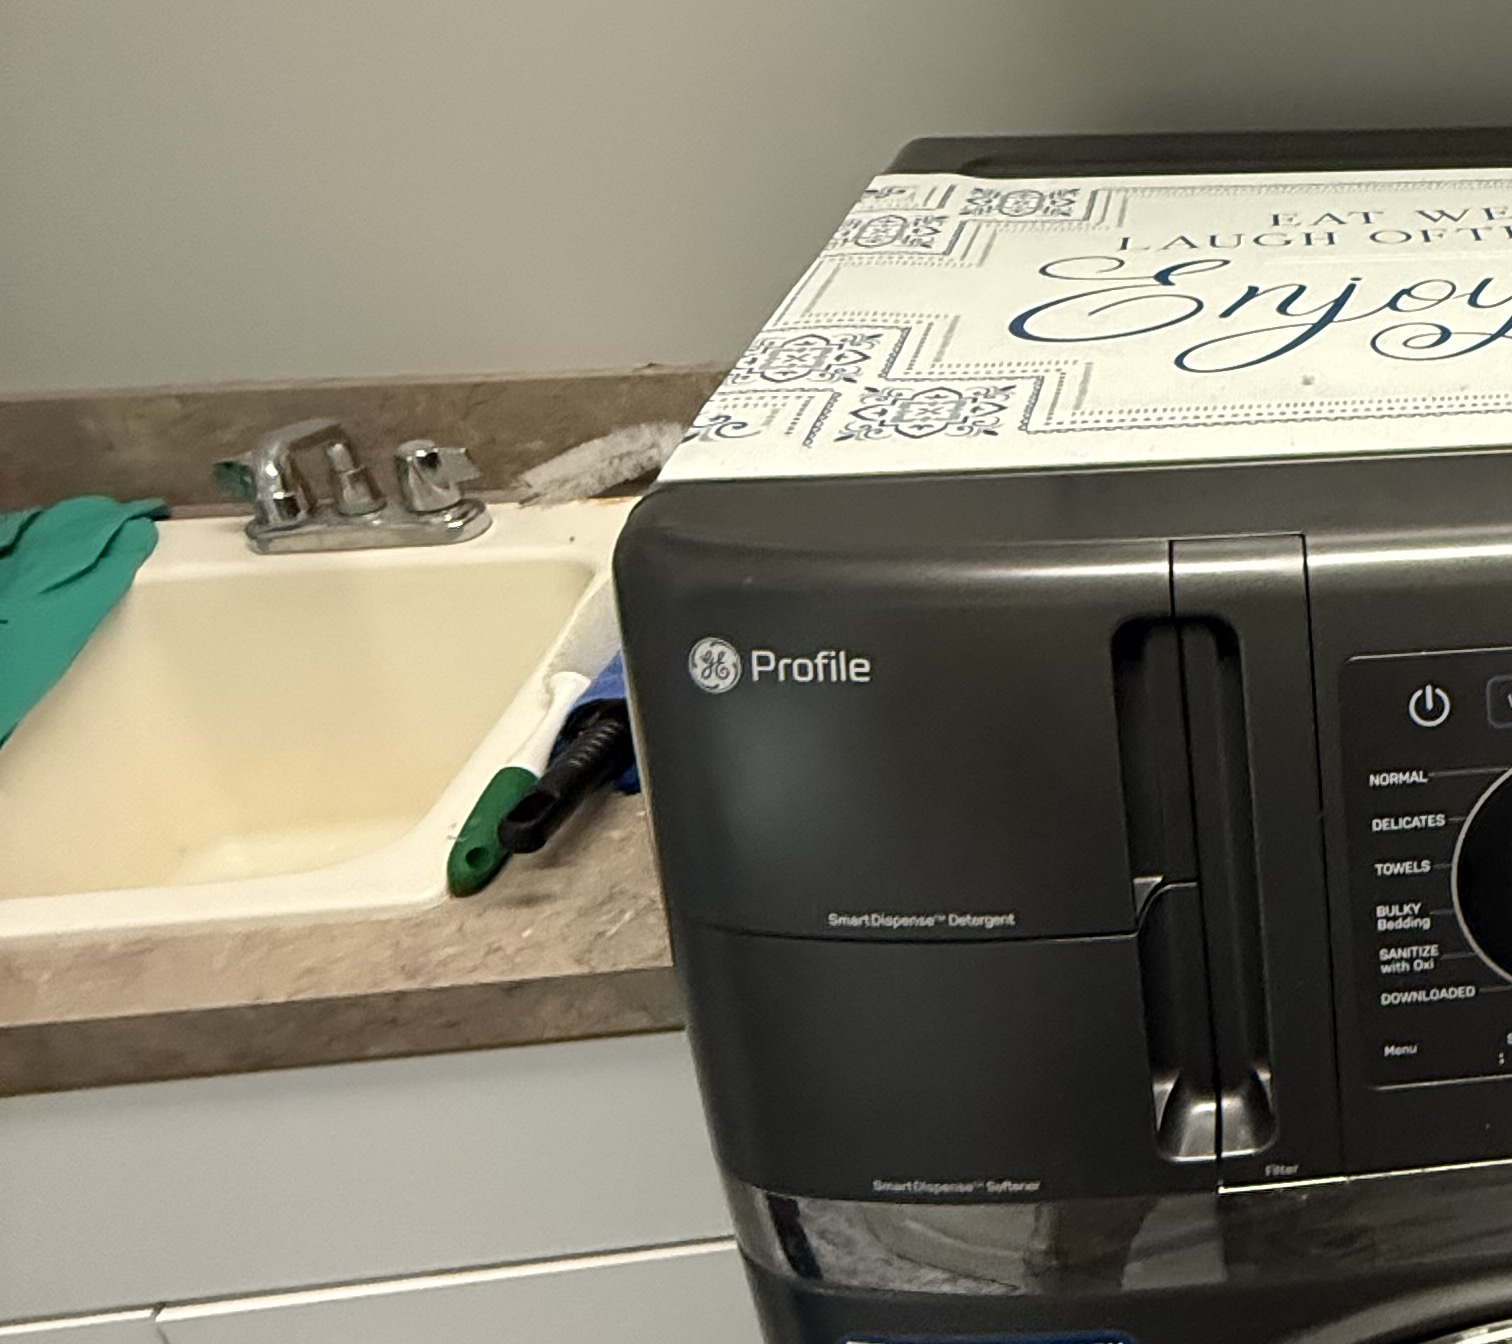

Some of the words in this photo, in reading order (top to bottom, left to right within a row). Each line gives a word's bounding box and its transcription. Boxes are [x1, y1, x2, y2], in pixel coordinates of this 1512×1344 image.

[1270, 210, 1384, 228] EAT
[1117, 232, 1337, 251] LAUGH
[750, 650, 872, 683] Profile
[1369, 770, 1428, 787] NORMAL
[1371, 813, 1446, 832] DELICATES
[1374, 859, 1431, 876] TOWELS
[1376, 902, 1422, 918] BULKY
[948, 912, 1016, 929] Detergent
[1377, 915, 1431, 931] Bedding
[1379, 944, 1439, 961] SANITIZE
[1380, 958, 1410, 974] with
[1412, 958, 1434, 972] Oxi
[1380, 985, 1476, 1006] DOWNLOADED
[1384, 1043, 1418, 1056] Menu
[986, 1178, 1040, 1193] Softener
